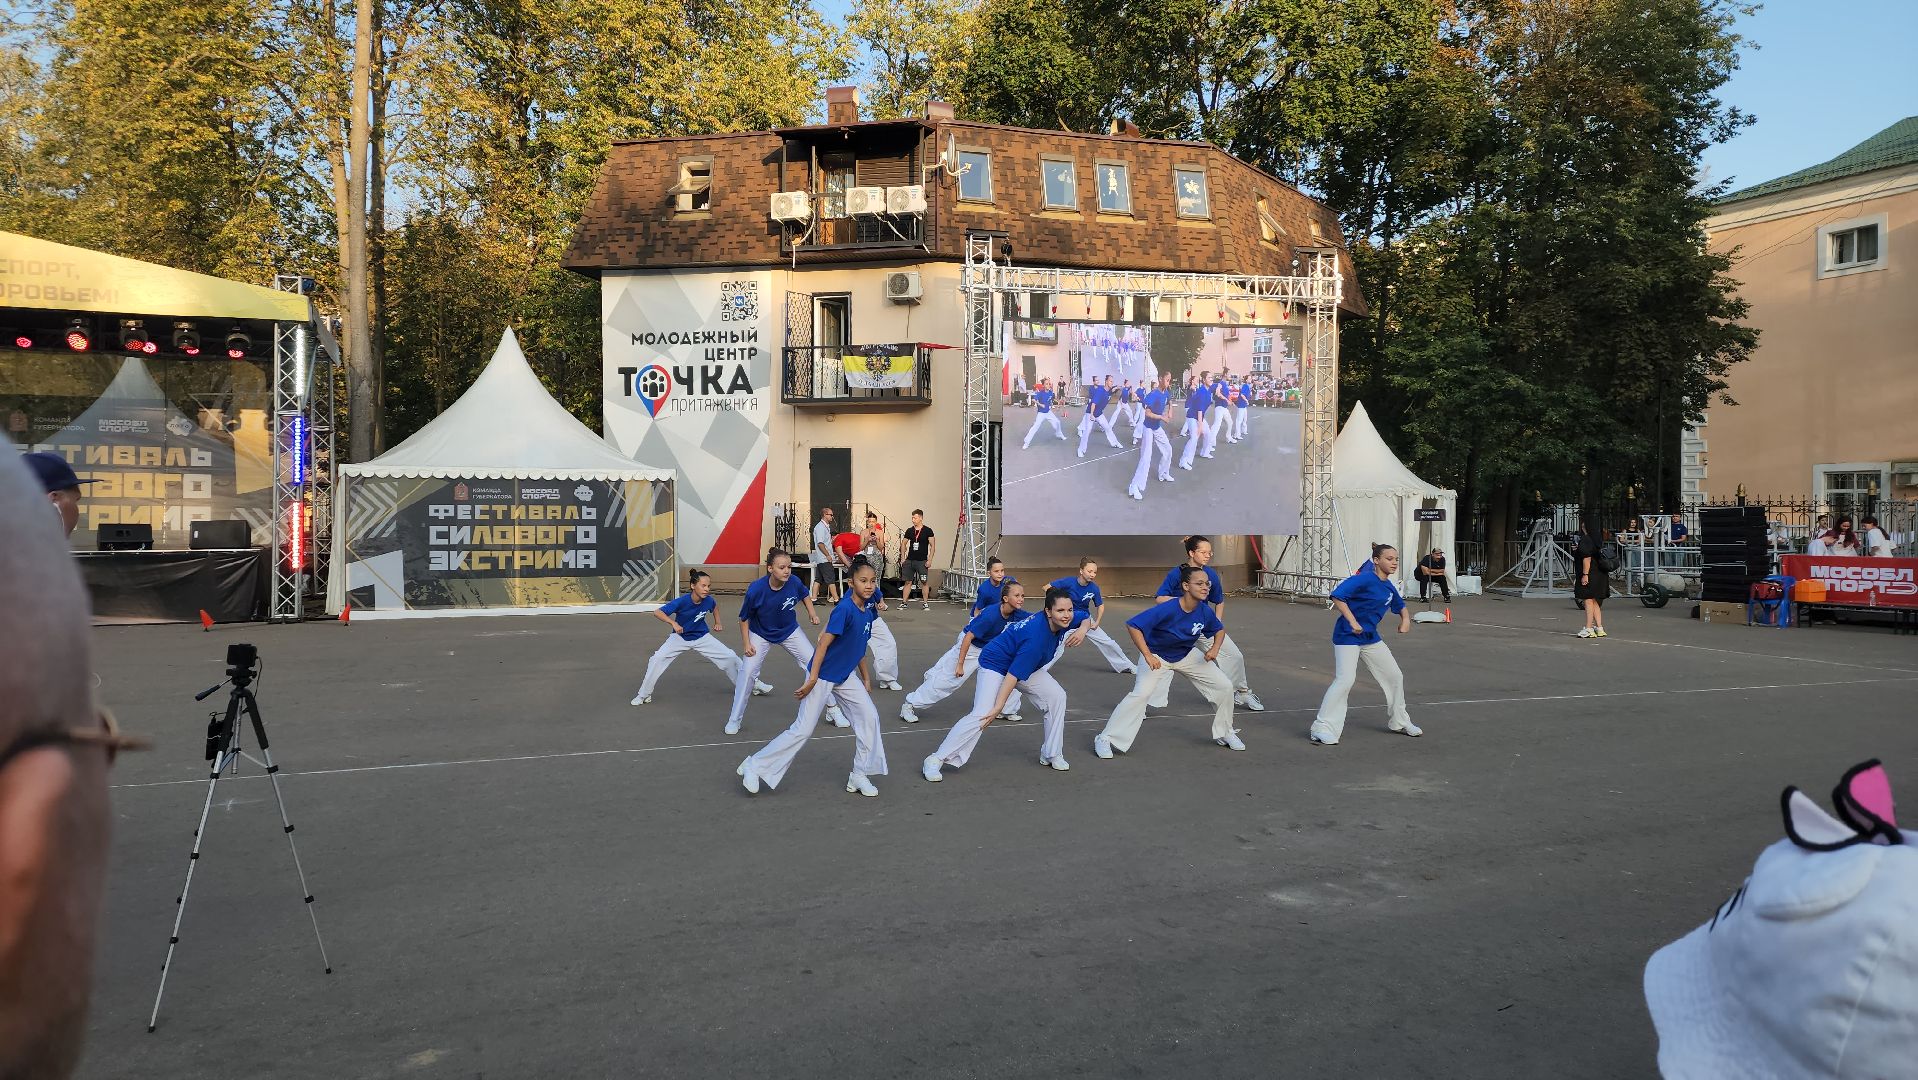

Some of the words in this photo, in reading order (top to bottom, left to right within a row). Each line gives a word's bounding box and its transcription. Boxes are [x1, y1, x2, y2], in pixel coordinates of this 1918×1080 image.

[0, 283, 119, 304] РОВЬЕМ!
[631, 326, 758, 346] МОЛОДЕЖНЫЙ
[704, 347, 758, 362] ЦЕНТР
[428, 504, 597, 520] ФЕСТИВАЛЬ
[428, 525, 597, 545] СИЛОВОГО
[428, 549, 597, 571] ЭКСТРИМА
[1810, 565, 1914, 582] МОСОБЛ
[1812, 578, 1891, 594] ПОРТ
